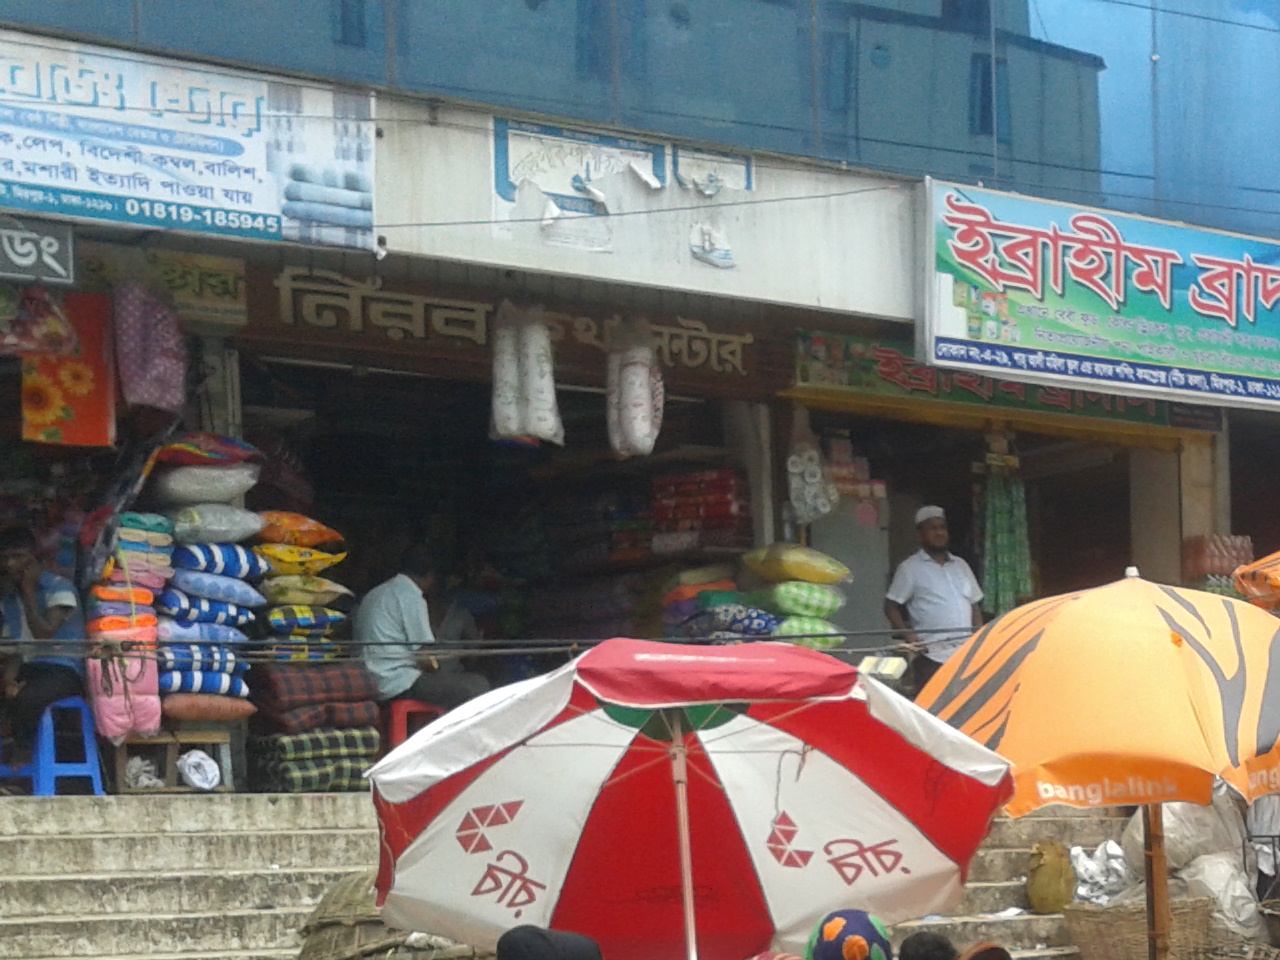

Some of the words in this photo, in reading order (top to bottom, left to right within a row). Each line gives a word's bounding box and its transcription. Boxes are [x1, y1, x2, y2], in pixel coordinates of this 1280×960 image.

[125, 199, 279, 233] 01819-185945
[942, 192, 1183, 312] ইব্রাহীম
[1036, 776, 1181, 804] banglalink
